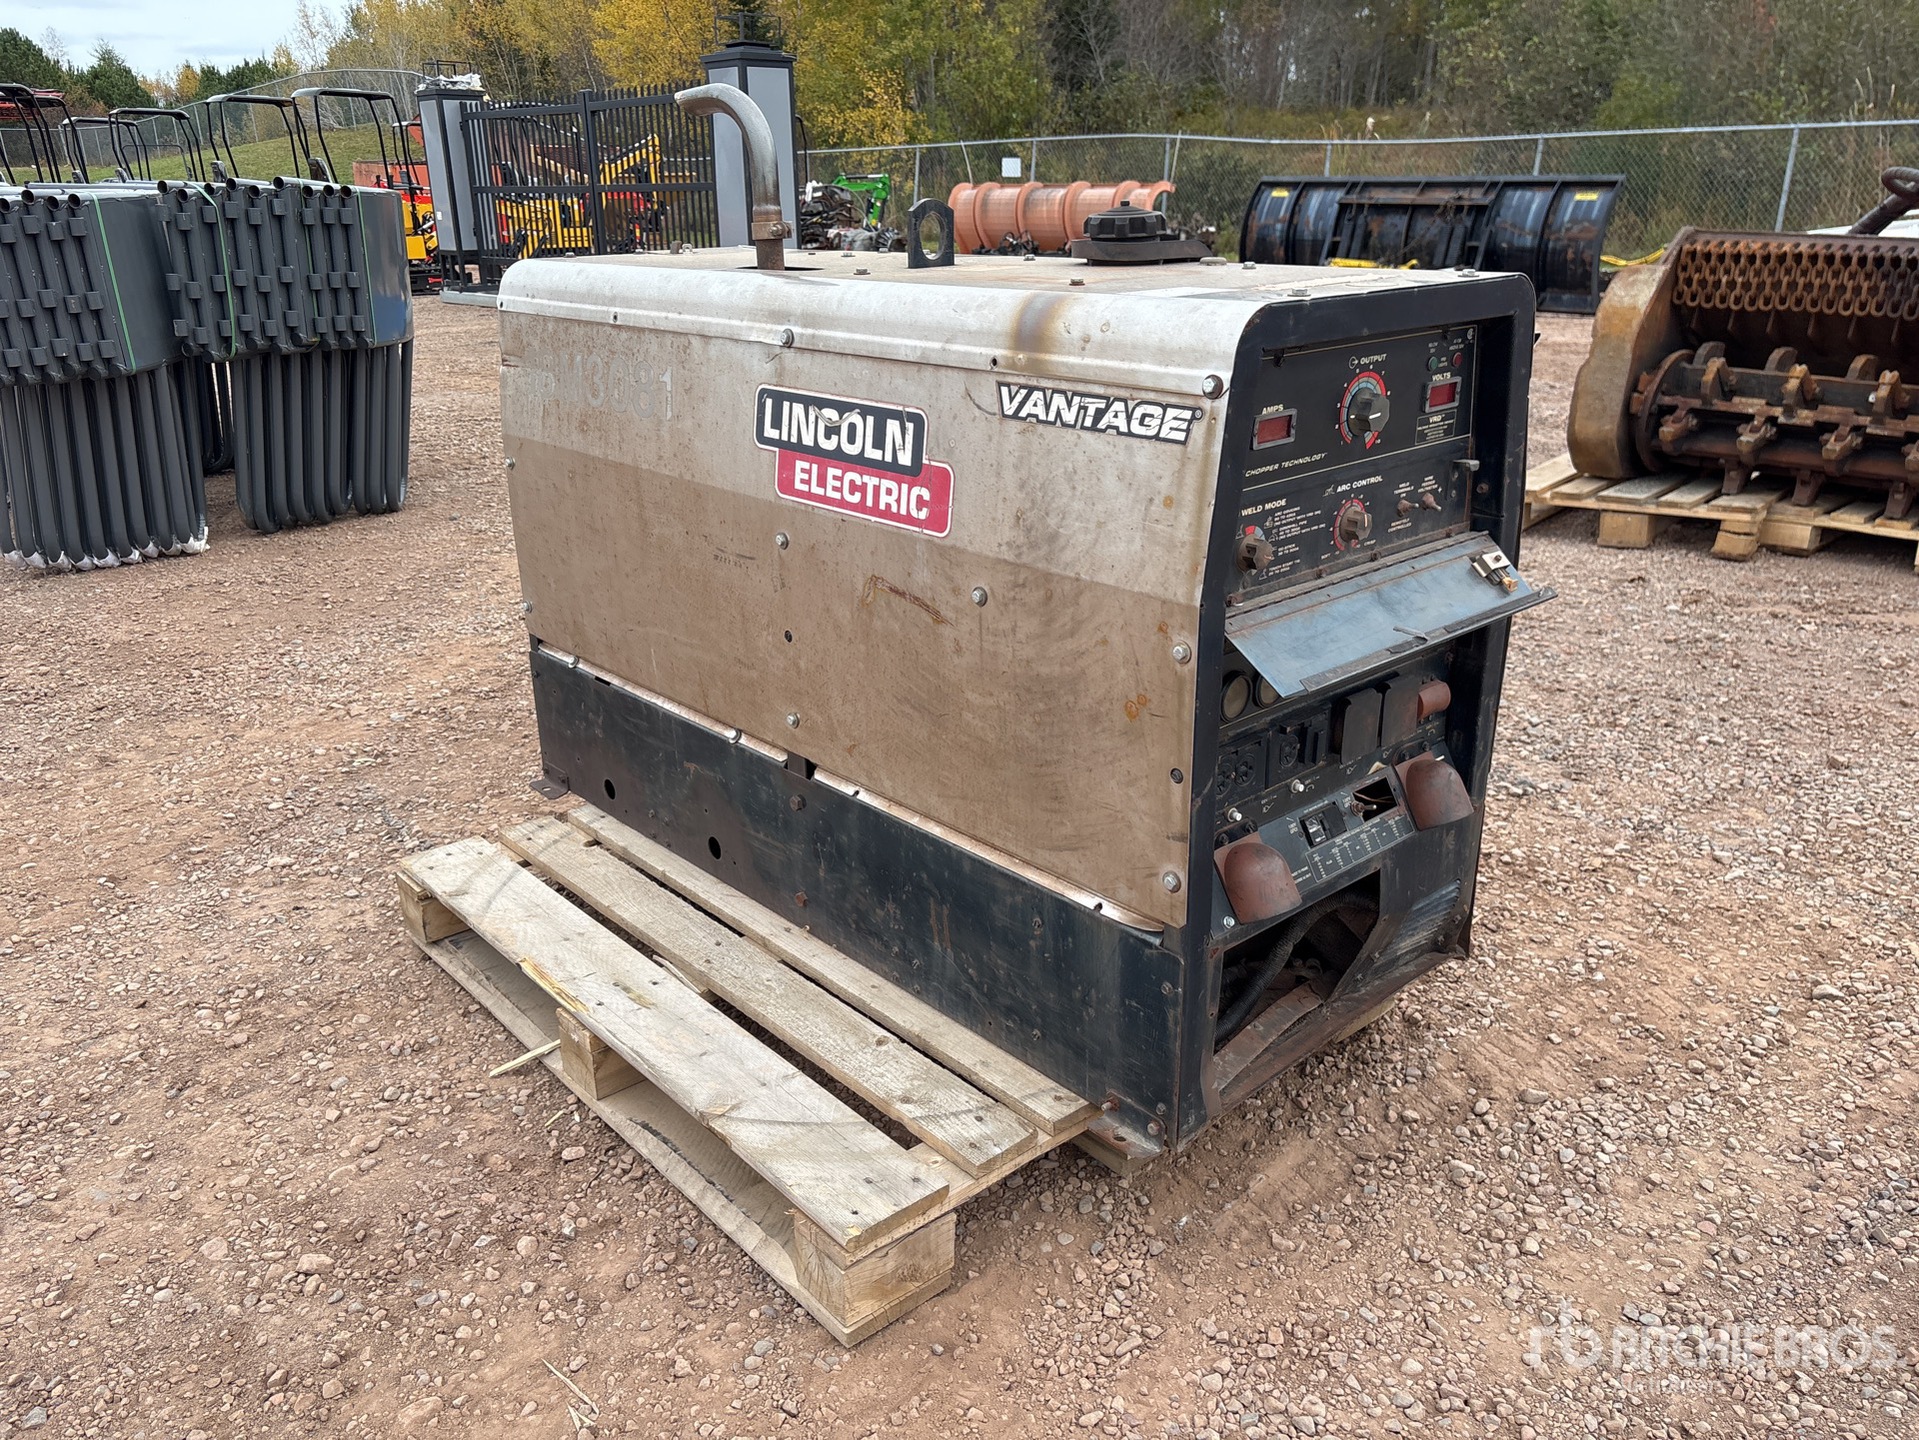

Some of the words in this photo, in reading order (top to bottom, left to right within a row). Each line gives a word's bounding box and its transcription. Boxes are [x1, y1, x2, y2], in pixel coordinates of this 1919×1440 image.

[1360, 354, 1387, 364] OUTPUT
[1432, 372, 1451, 381] VOLTS
[1000, 385, 1193, 441] VANTAGE
[1262, 404, 1284, 415] AMPS
[763, 397, 914, 467] LINCOLN
[1246, 464, 1279, 477] CHOPPER
[1281, 453, 1326, 468] TECHNOLOGY
[793, 459, 931, 520] ELECTRIC
[1337, 484, 1351, 492] ARC
[1352, 475, 1383, 488] CONTROL
[1241, 505, 1263, 516] WELD
[1265, 499, 1286, 510] MODE
